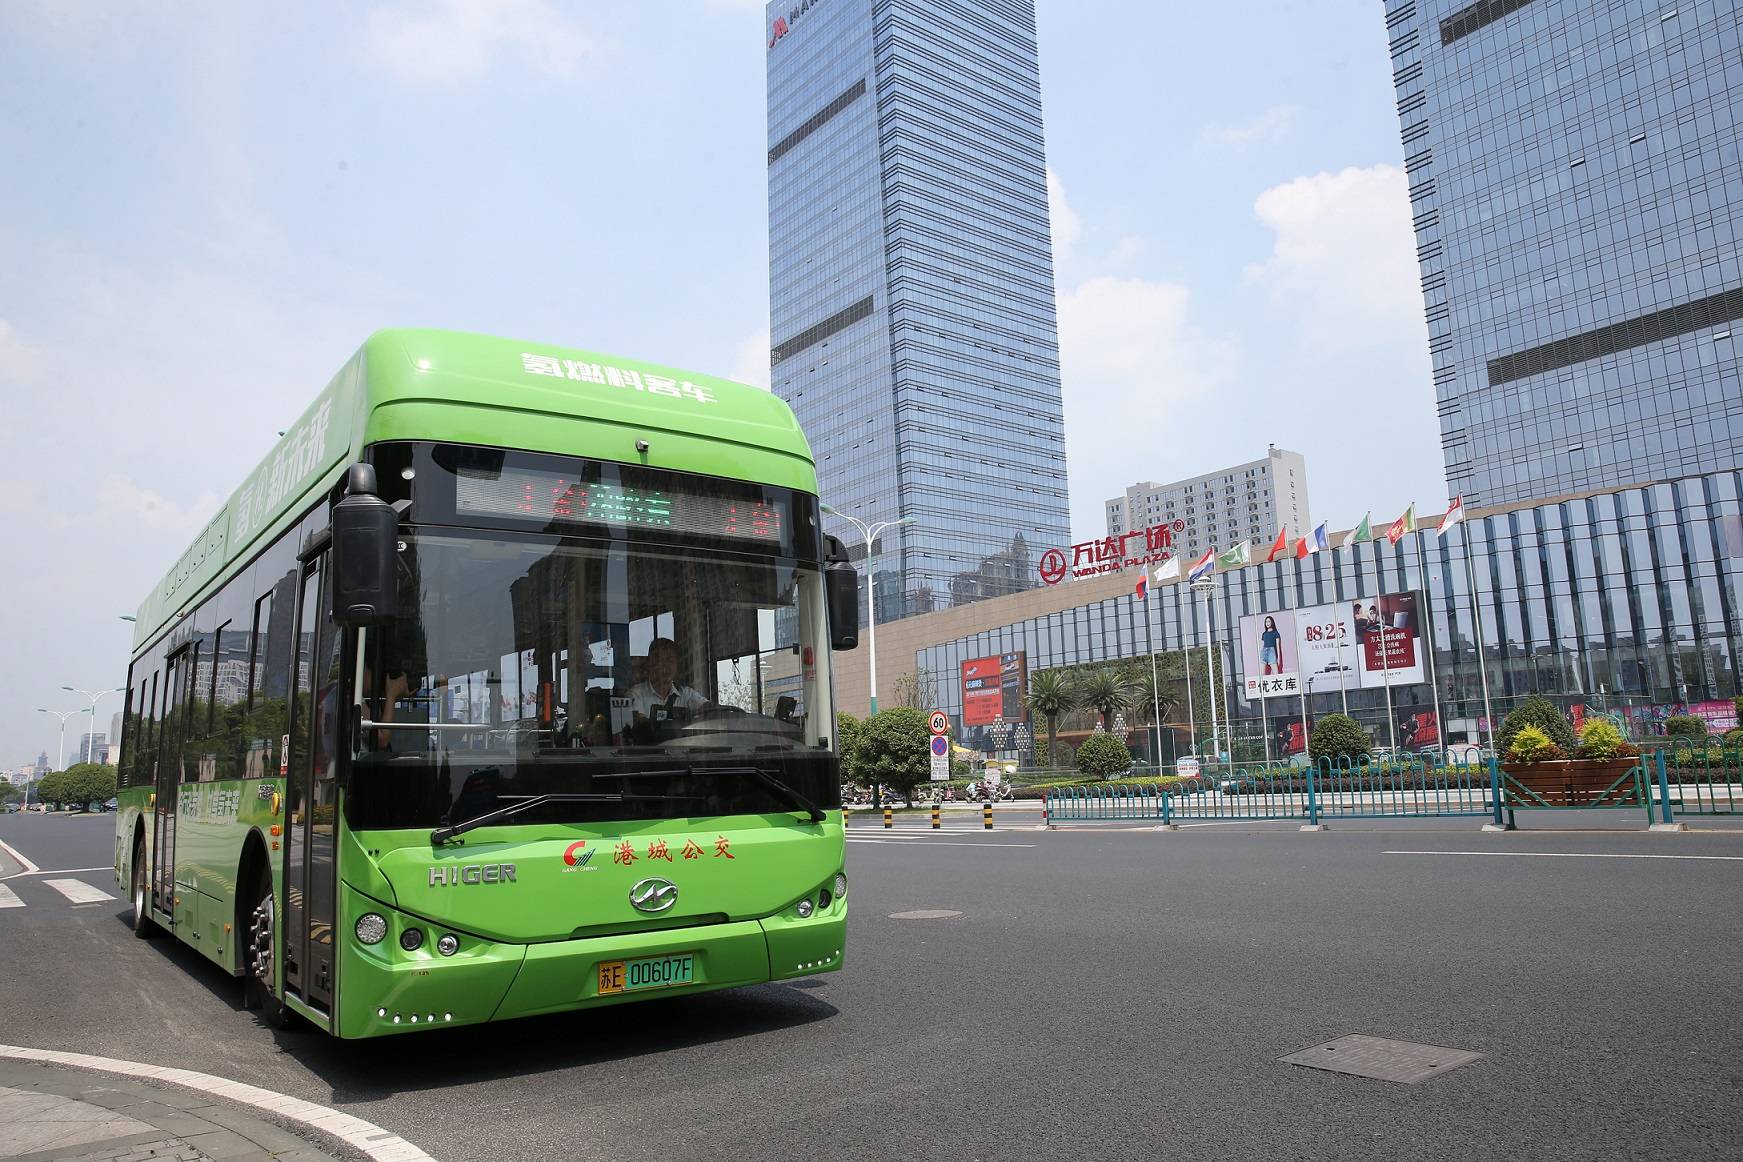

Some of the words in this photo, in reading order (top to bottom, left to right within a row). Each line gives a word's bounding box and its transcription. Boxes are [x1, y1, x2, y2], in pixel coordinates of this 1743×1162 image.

[520, 352, 718, 404] 氢燃料客车
[1071, 523, 1172, 567] 万达广场
[1072, 562, 1120, 578] WANDA
[1124, 551, 1171, 568] PLAZA
[1257, 677, 1297, 694] 优衣库
[933, 717, 944, 728] 60
[613, 835, 736, 866] 港城公交
[428, 863, 517, 887] HIGER
[629, 956, 692, 986] 00607F
